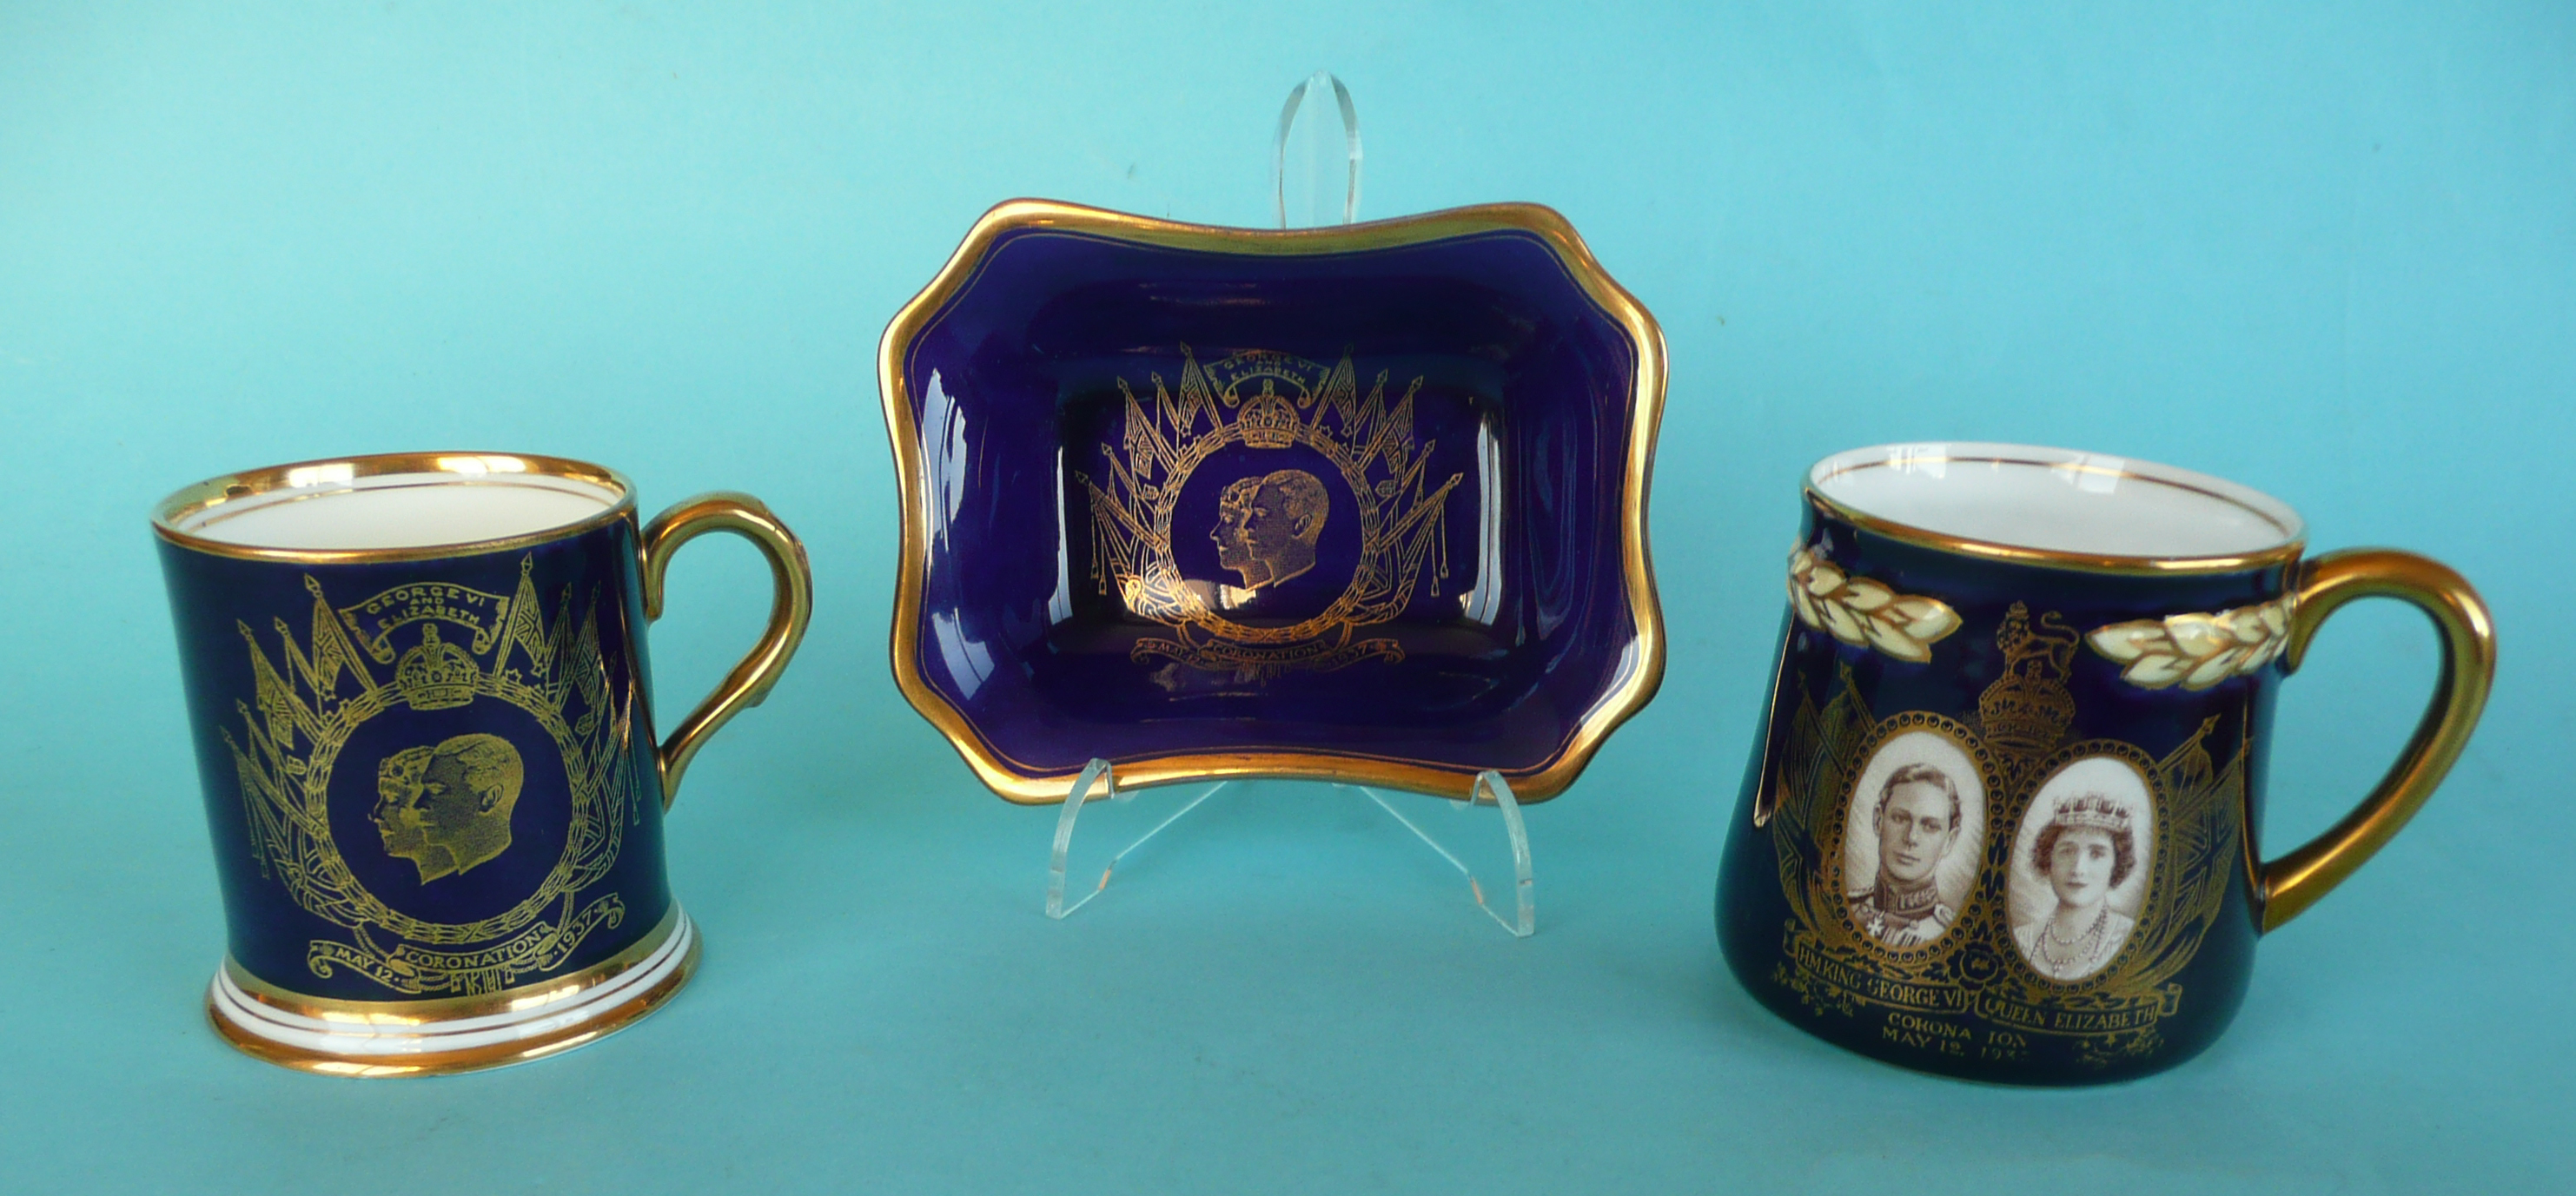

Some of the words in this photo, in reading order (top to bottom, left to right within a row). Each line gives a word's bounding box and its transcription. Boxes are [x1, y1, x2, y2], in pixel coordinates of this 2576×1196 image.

[1223, 352, 1293, 370] GEORGE
[1297, 360, 1313, 372] VI
[1230, 365, 1306, 384] ELIZABETH
[367, 586, 460, 614] GEORGE
[466, 592, 485, 607] VI
[377, 605, 480, 630] ELIZABETH
[1213, 644, 1319, 660] CORONATION
[335, 947, 375, 970] MAY
[405, 932, 541, 969] CORONATION
[1867, 978, 1940, 1007] GEORGE
[1944, 989, 1962, 1008] VI
[1984, 997, 2047, 1026] QUEEN
[2054, 1006, 2156, 1029] ELIZABETH
[1882, 1025, 1933, 1048] MAY
